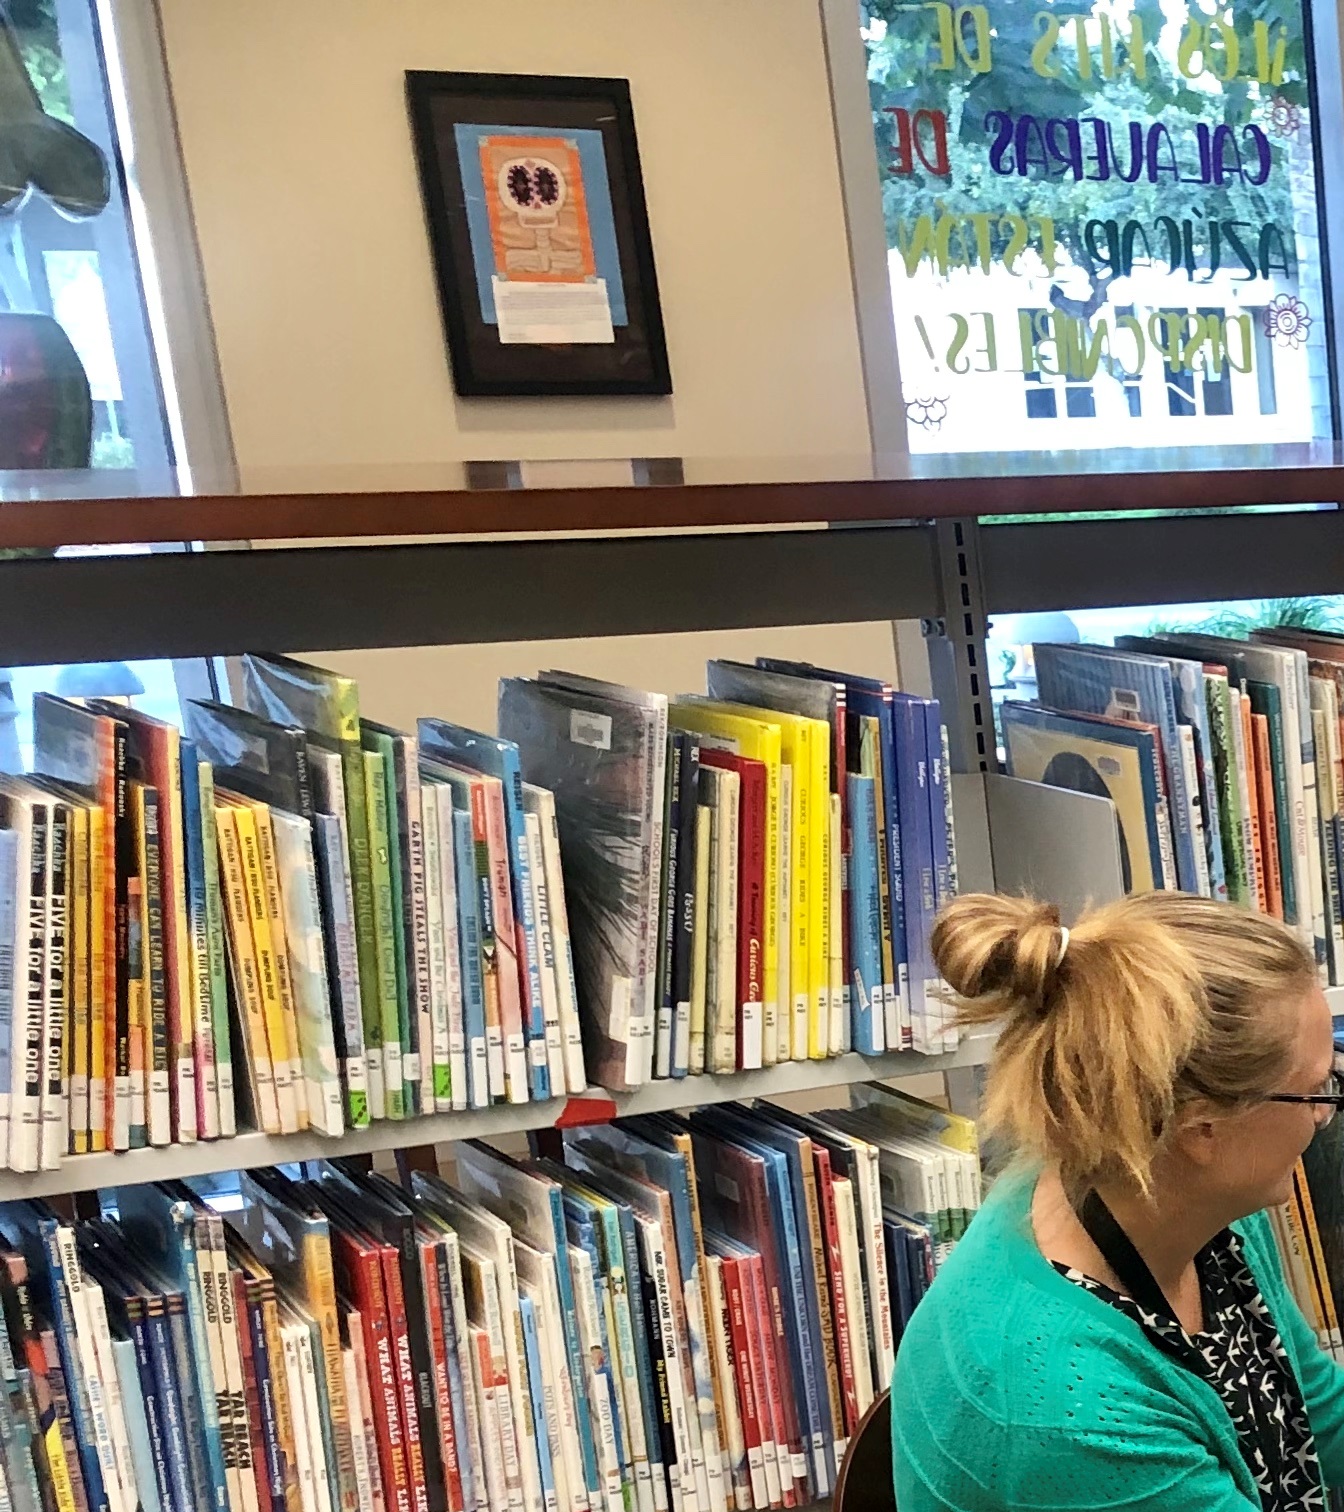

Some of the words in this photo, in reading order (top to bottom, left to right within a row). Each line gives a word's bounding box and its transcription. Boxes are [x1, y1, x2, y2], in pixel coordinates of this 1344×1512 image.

[410, 820, 422, 865] GARTH
[517, 835, 528, 869] BEST
[413, 872, 424, 893] PIG
[520, 871, 533, 925] FRIENDS
[29, 896, 45, 939] FIVE
[52, 895, 65, 938] FIVE
[414, 899, 426, 943] STEALS
[536, 884, 549, 926] LITTLE
[28, 946, 43, 974] for
[51, 946, 64, 972] for
[197, 953, 208, 970] till
[417, 948, 428, 972] THE
[525, 929, 537, 968] THINK
[541, 931, 553, 968] CLAM
[27, 980, 43, 991] a
[50, 979, 63, 991] a
[198, 972, 212, 1022] Bedtime
[419, 978, 430, 1013] SHOW
[529, 972, 541, 1007] ALIKE
[26, 999, 42, 1040] little
[49, 998, 62, 1041] little
[25, 1047, 41, 1083] one
[48, 1046, 61, 1081] one
[873, 1222, 883, 1239] The
[63, 1242, 80, 1293] RINGGOLD
[653, 1250, 663, 1265] MR.
[874, 1242, 885, 1274] Silence
[202, 1271, 216, 1323] RINGGOLD
[217, 1271, 232, 1324] RINGGOLD
[656, 1268, 667, 1294] SUGAR
[832, 1270, 844, 1295] SEND
[877, 1277, 886, 1285] in
[878, 1289, 888, 1301] the
[659, 1295, 670, 1319] CAME
[836, 1297, 846, 1313] FOR
[663, 1321, 672, 1332] TO
[879, 1305, 891, 1349] Mountains
[376, 1337, 393, 1383] WHAT
[395, 1334, 413, 1380] WHAT
[664, 1334, 675, 1358] TOWN
[418, 1371, 431, 1407] BLACKOUT
[433, 1362, 447, 1390] WANT
[215, 1389, 232, 1420] TAR
[230, 1390, 245, 1419] TAR
[401, 1384, 419, 1441] ANIMALS
[437, 1390, 449, 1404] TO
[440, 1406, 451, 1419] BE
[598, 1398, 611, 1421] ZOO
[382, 1387, 401, 1444] ANIMALS
[441, 1420, 452, 1430] IN
[497, 1393, 513, 1442] LIBRARY
[219, 1422, 237, 1468] BEACH
[234, 1422, 252, 1469] BEACH
[443, 1432, 454, 1441] A
[603, 1423, 615, 1445] DAY
[390, 1447, 406, 1485] REALLY
[408, 1444, 424, 1481] REALLY
[445, 1441, 458, 1472] BAND?
[504, 1444, 516, 1466] DAY
[412, 1485, 427, 1512] LIK
